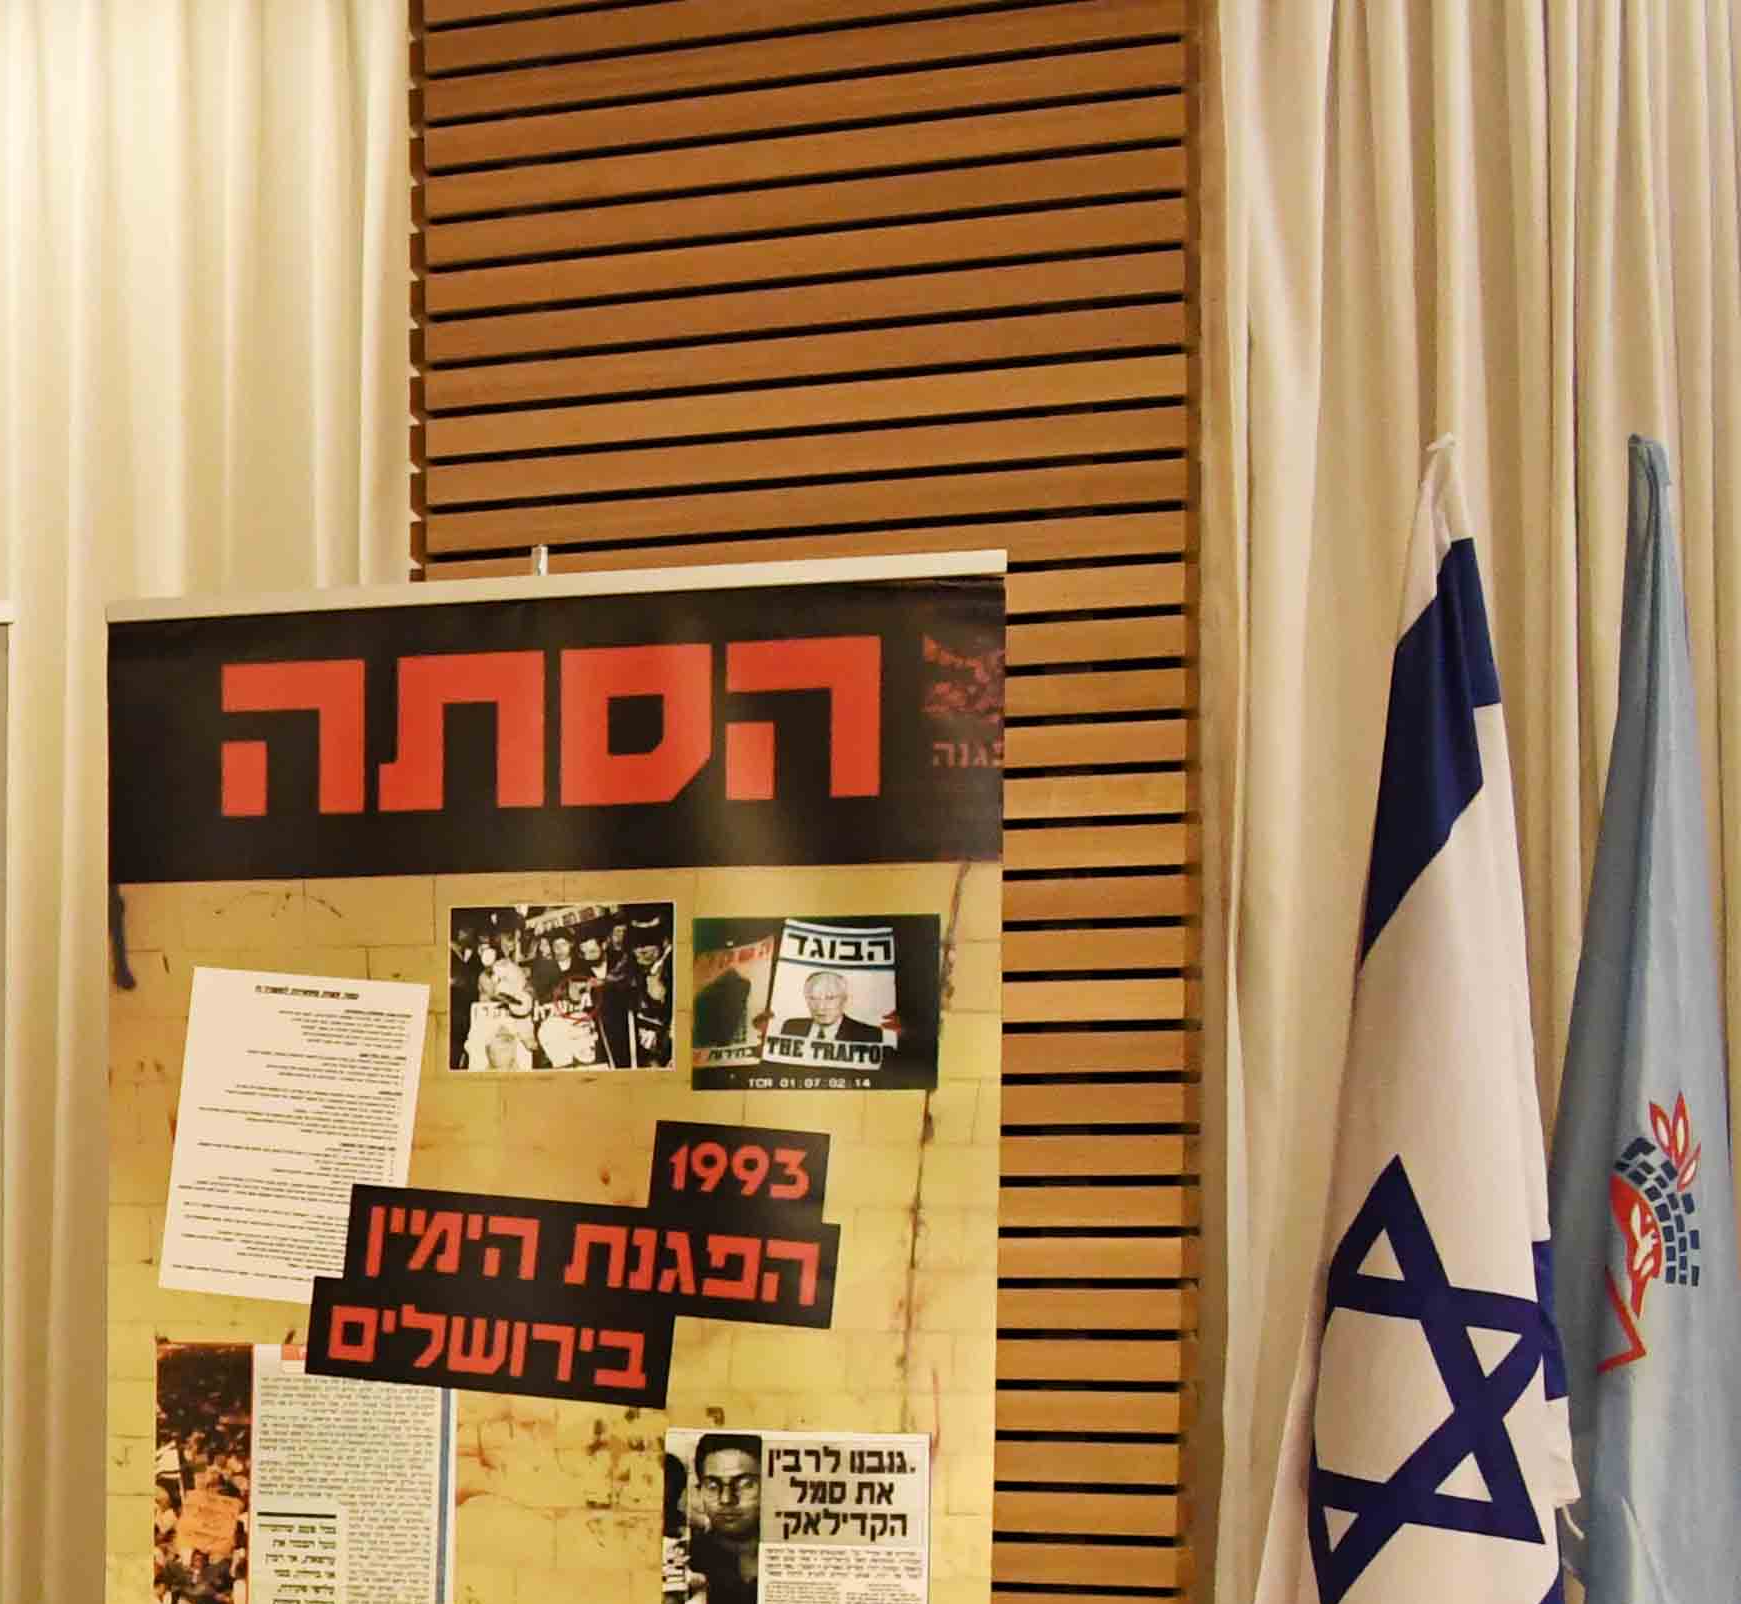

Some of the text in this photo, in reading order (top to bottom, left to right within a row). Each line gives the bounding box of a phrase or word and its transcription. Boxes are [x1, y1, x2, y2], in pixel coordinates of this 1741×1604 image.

[220, 635, 882, 817] הסתה
[787, 933, 891, 961] הבוגד
[767, 1037, 894, 1064] THE TRAITO
[669, 1141, 809, 1200] 1993
[367, 1206, 821, 1307] הפגנת הימין
[328, 1303, 647, 1390] בירושלים
[768, 1446, 841, 1477] לרבין
[790, 1477, 894, 1505] את סמל
